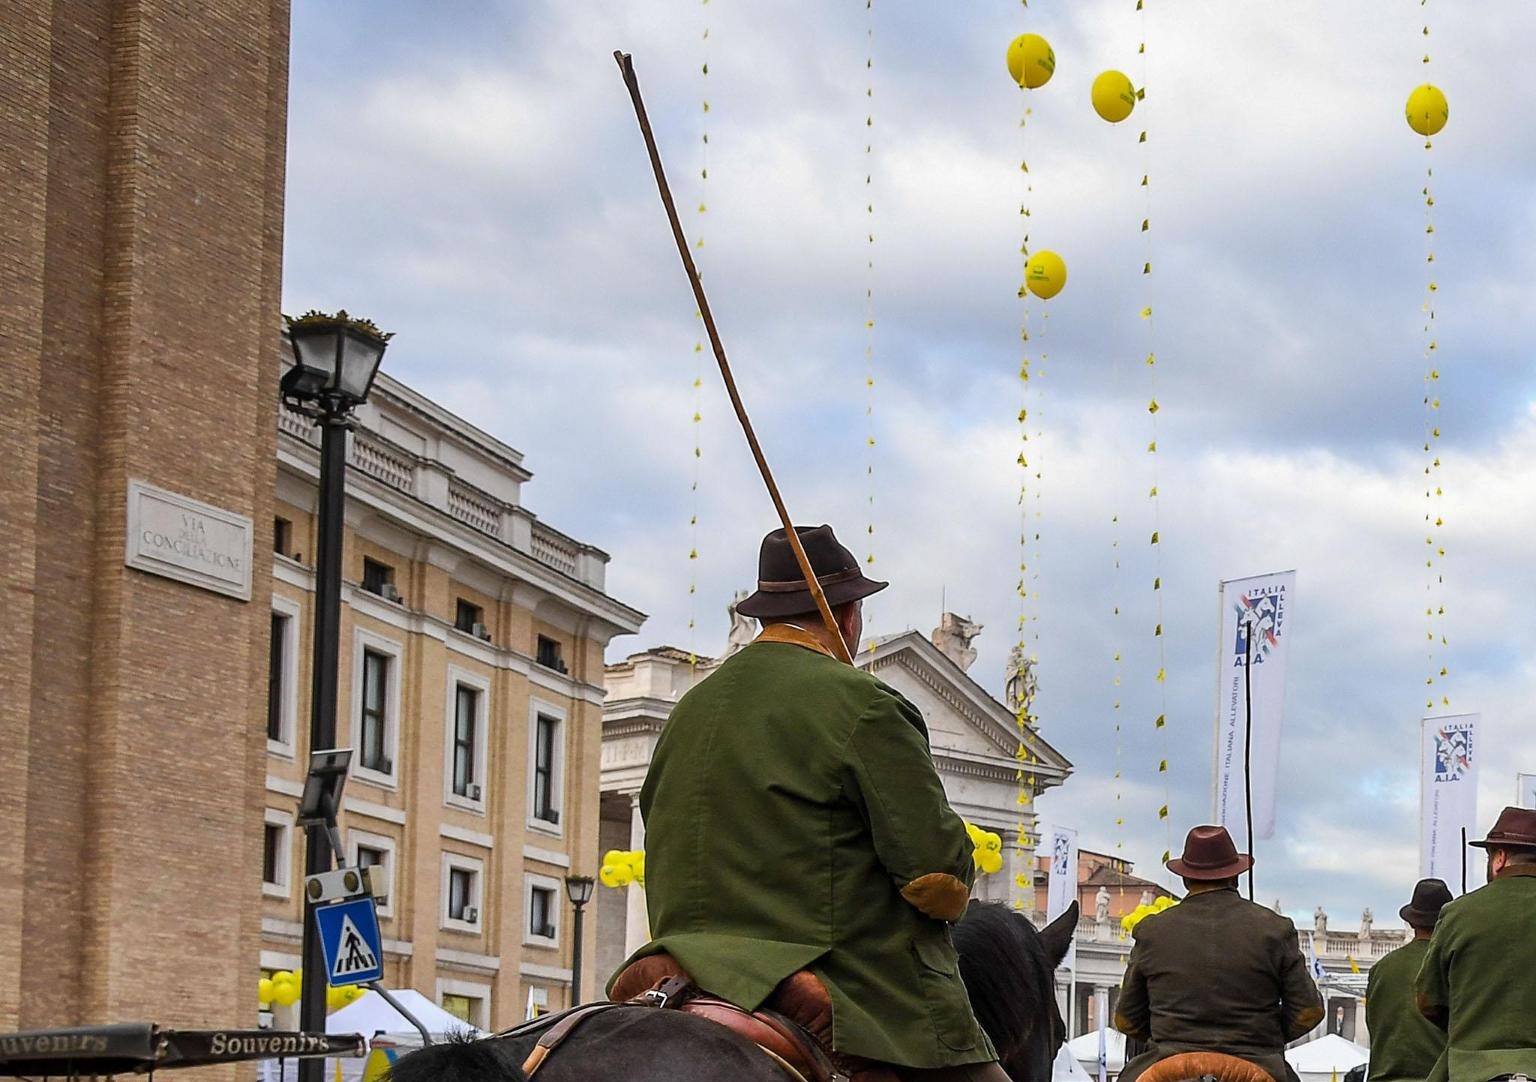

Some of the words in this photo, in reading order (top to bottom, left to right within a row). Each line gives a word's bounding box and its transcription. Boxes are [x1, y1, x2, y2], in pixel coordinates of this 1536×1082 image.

[182, 513, 205, 534] VIA
[1248, 585, 1286, 597] ITALIA
[1234, 654, 1264, 667] A..A.
[1225, 730, 1234, 768] ITALIANA
[1230, 676, 1239, 726] ALLEVATORI
[1443, 723, 1473, 731] ITALIA
[1, 1034, 109, 1054] uvenirs
[211, 1032, 329, 1055] Souvenirs
